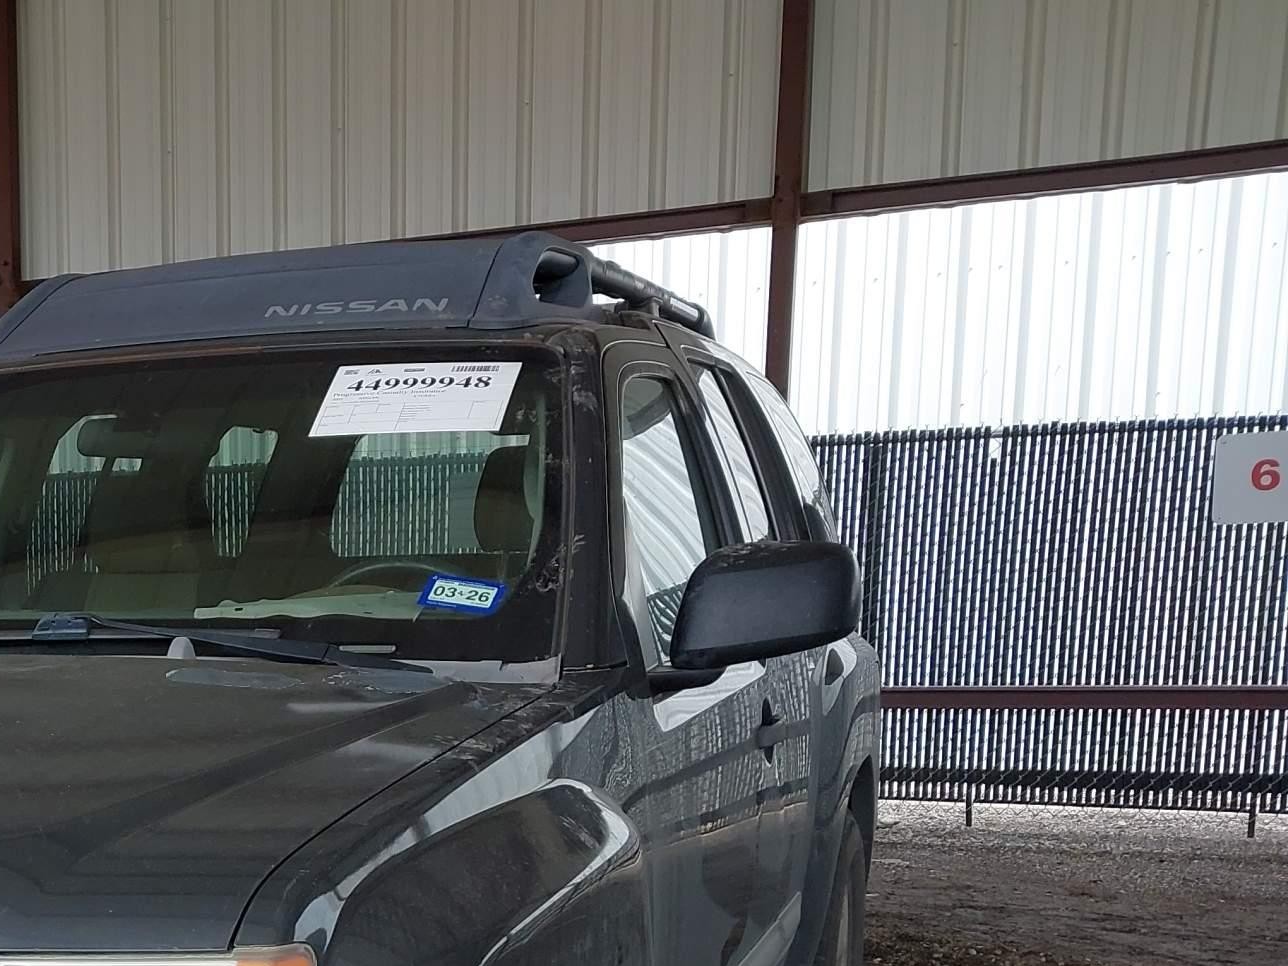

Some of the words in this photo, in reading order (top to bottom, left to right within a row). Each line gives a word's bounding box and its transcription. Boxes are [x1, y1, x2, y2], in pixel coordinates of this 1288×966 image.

[264, 298, 449, 318] NISSAN
[346, 375, 492, 392] 44999948
[1251, 458, 1281, 491] 6
